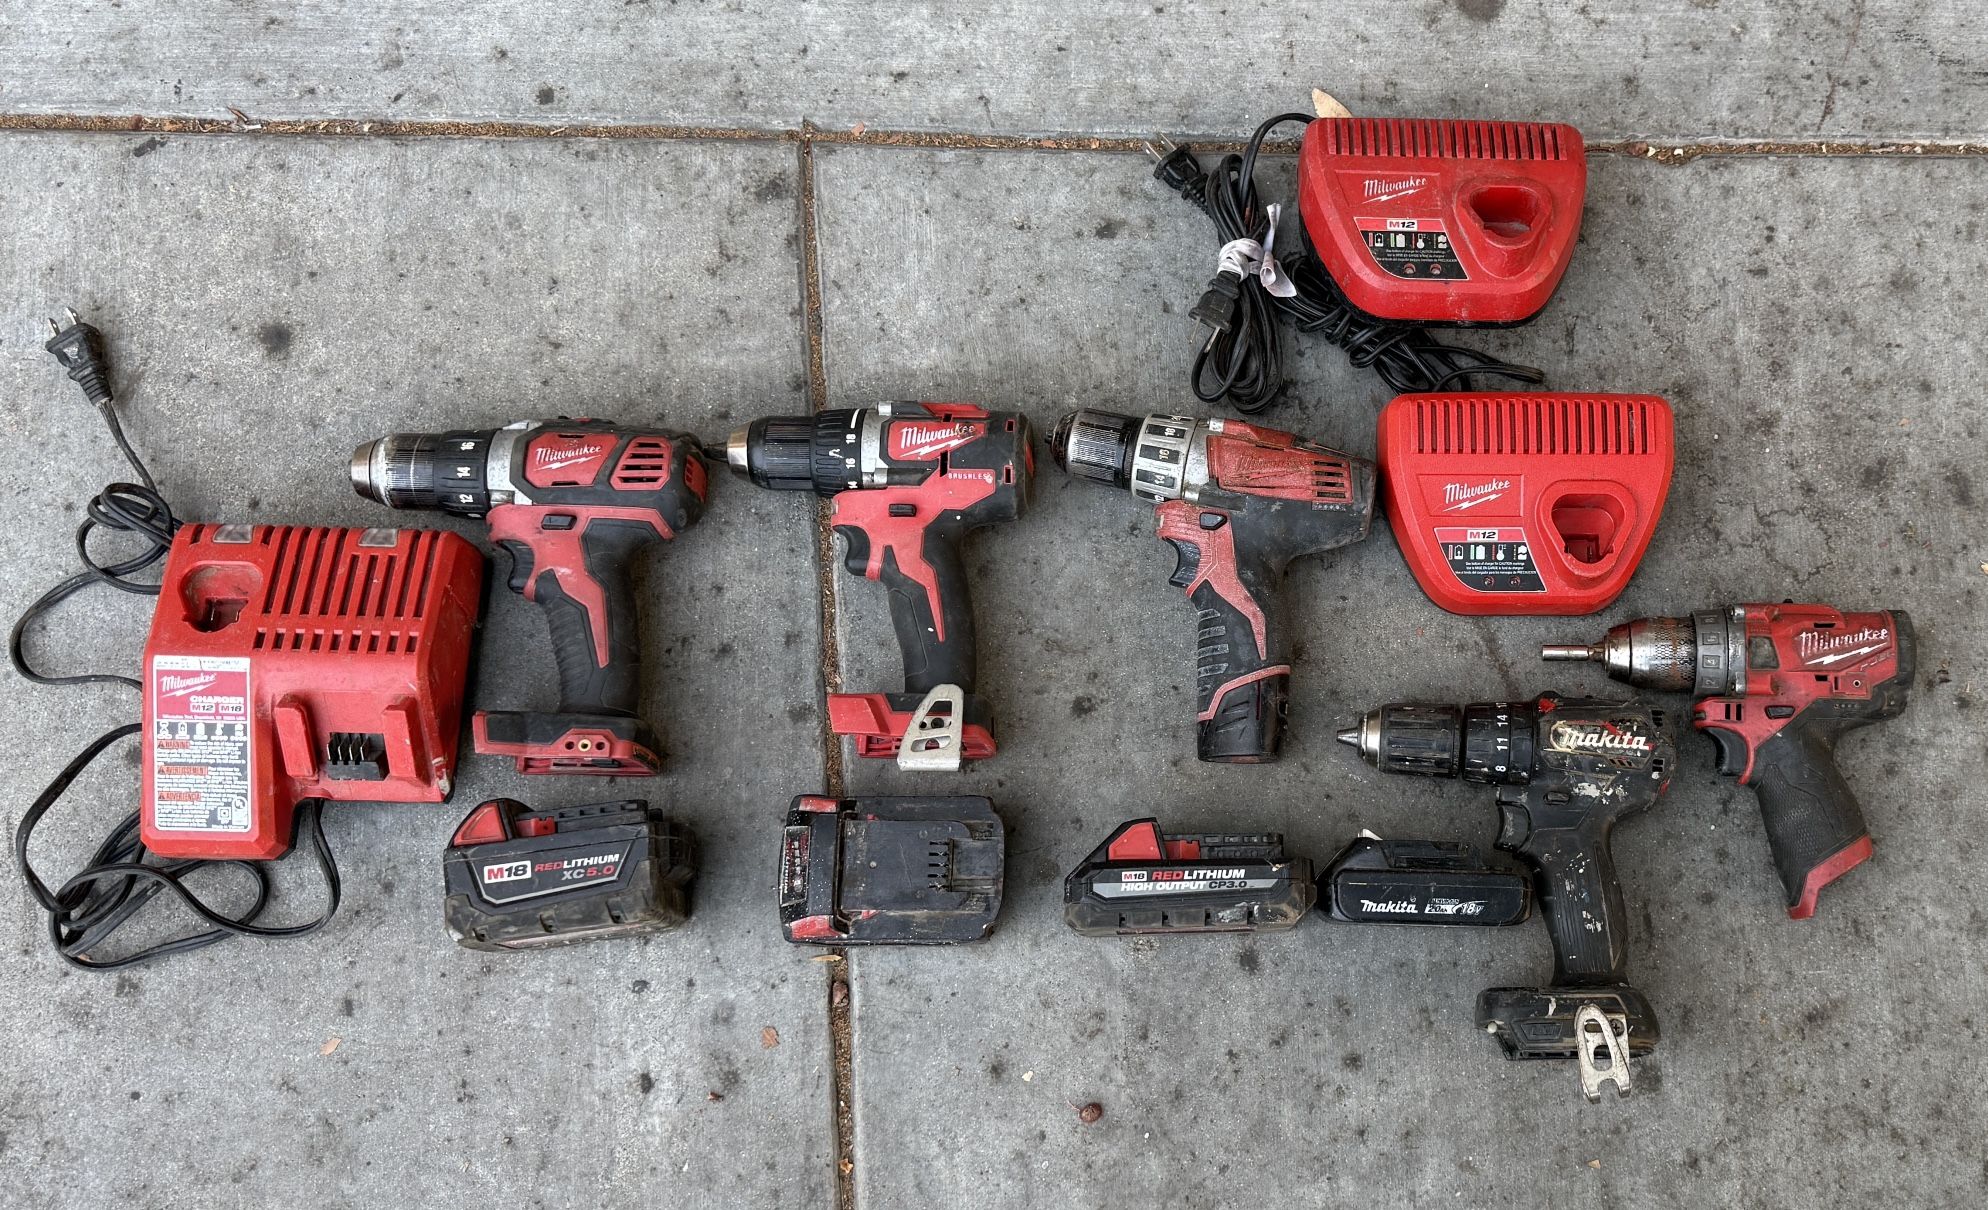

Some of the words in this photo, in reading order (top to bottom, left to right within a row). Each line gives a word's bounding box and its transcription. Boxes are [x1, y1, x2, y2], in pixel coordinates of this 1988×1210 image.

[1363, 175, 1427, 198] Milwaukee
[1389, 221, 1416, 229] M12
[899, 422, 976, 449] Milwaukee
[456, 466, 471, 478] 14
[1154, 474, 1166, 485] 14
[1443, 478, 1511, 505] Milwaukee
[460, 494, 474, 503] 12
[1469, 531, 1497, 539] M12
[1796, 628, 1888, 658] Milwaukee
[160, 672, 217, 692] Milwaukee
[189, 695, 244, 704] CHARGER
[1496, 714, 1509, 728] 14
[1496, 737, 1509, 751] 11
[1494, 765, 1507, 773] 8
[486, 863, 529, 881] M18
[534, 853, 620, 872] REDLITHIUM
[1152, 868, 1246, 881] REDLITHIUM
[1120, 882, 1154, 892] HIGH
[1155, 880, 1208, 890] OUTPUT
[1208, 880, 1248, 889] CP3.0
